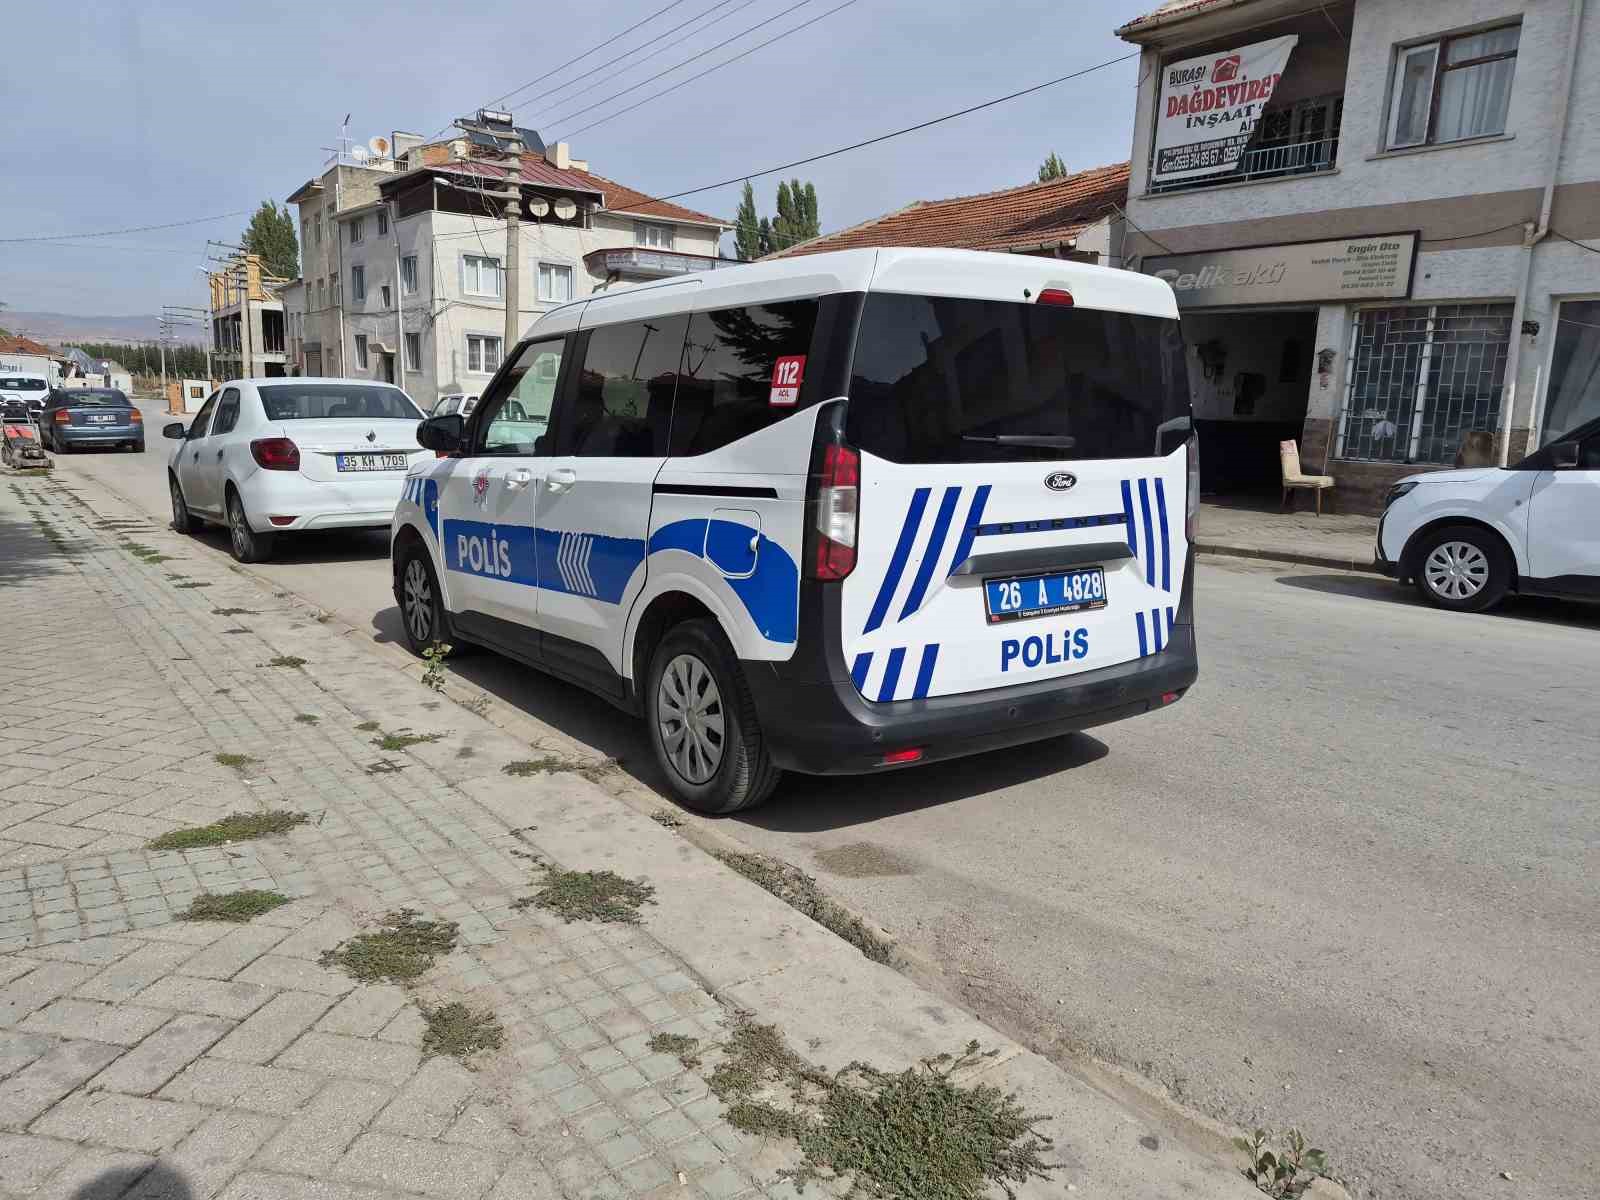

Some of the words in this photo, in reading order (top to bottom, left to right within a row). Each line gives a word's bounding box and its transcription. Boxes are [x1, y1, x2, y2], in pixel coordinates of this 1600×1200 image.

[1169, 66, 1206, 85] BURASI
[1347, 244, 1377, 254] Engin
[1379, 242, 1400, 251] Oto
[777, 360, 800, 385] 112
[344, 456, 357, 467] 35
[362, 455, 375, 467] KH
[381, 455, 405, 466] 1709
[1052, 474, 1073, 490] Ford
[999, 581, 1022, 610] 26
[1038, 579, 1048, 606] A
[1063, 572, 1103, 601] 4828
